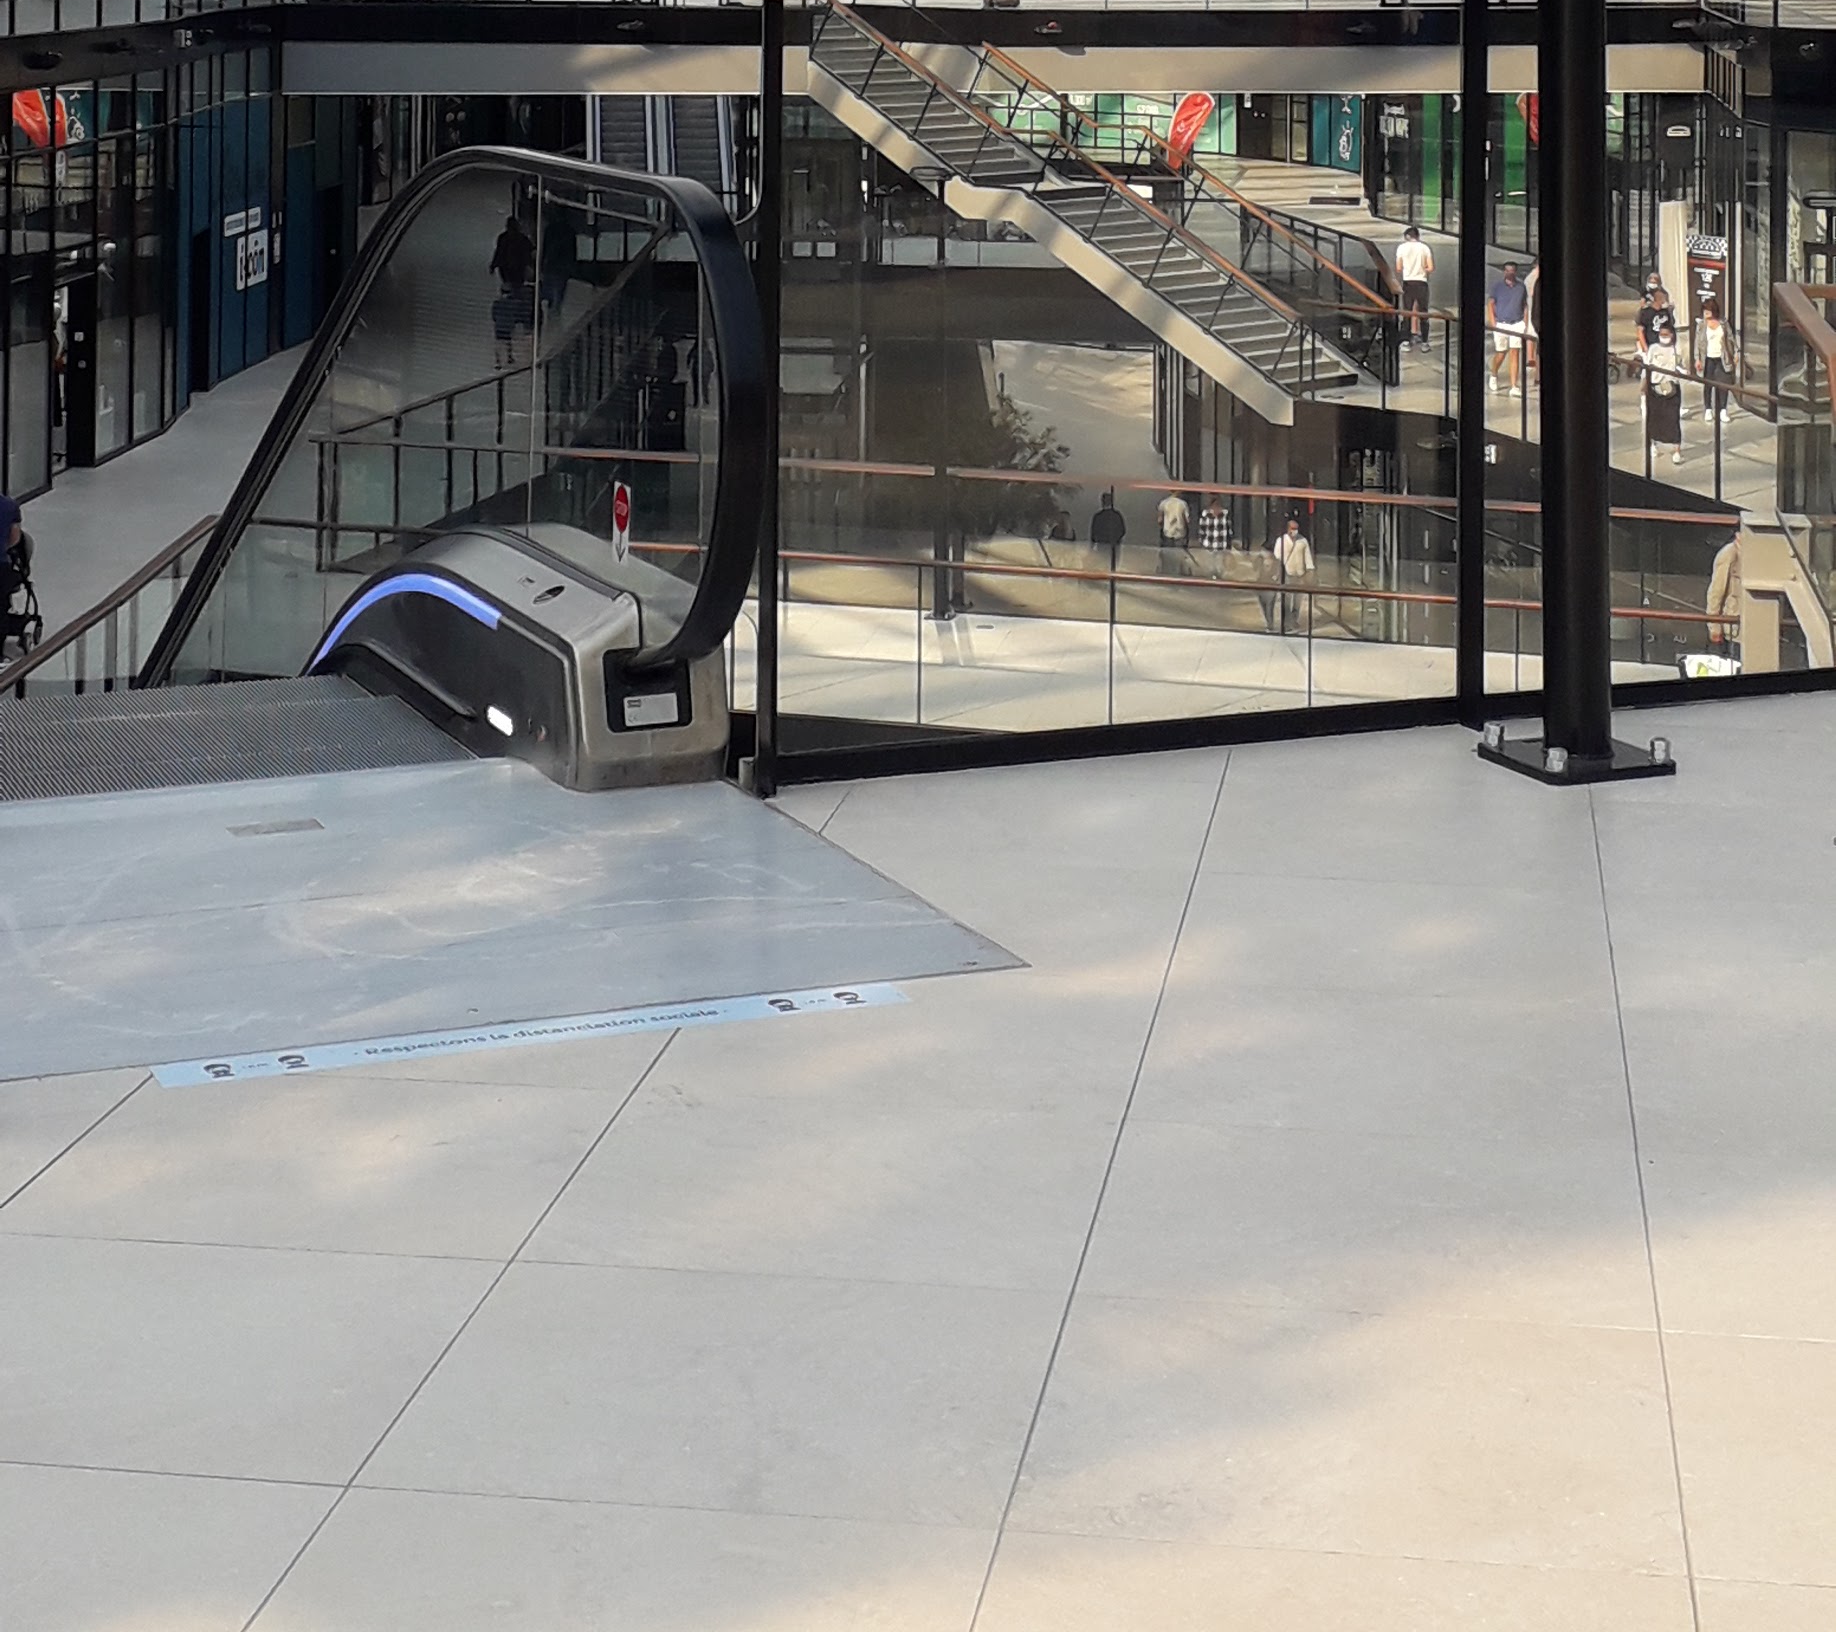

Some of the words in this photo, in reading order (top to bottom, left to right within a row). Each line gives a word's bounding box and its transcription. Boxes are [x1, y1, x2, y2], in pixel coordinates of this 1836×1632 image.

[365, 1035, 487, 1056] Respectons
[489, 1032, 510, 1041] la
[513, 1017, 646, 1039] distanciation
[650, 1009, 719, 1022] sociale
